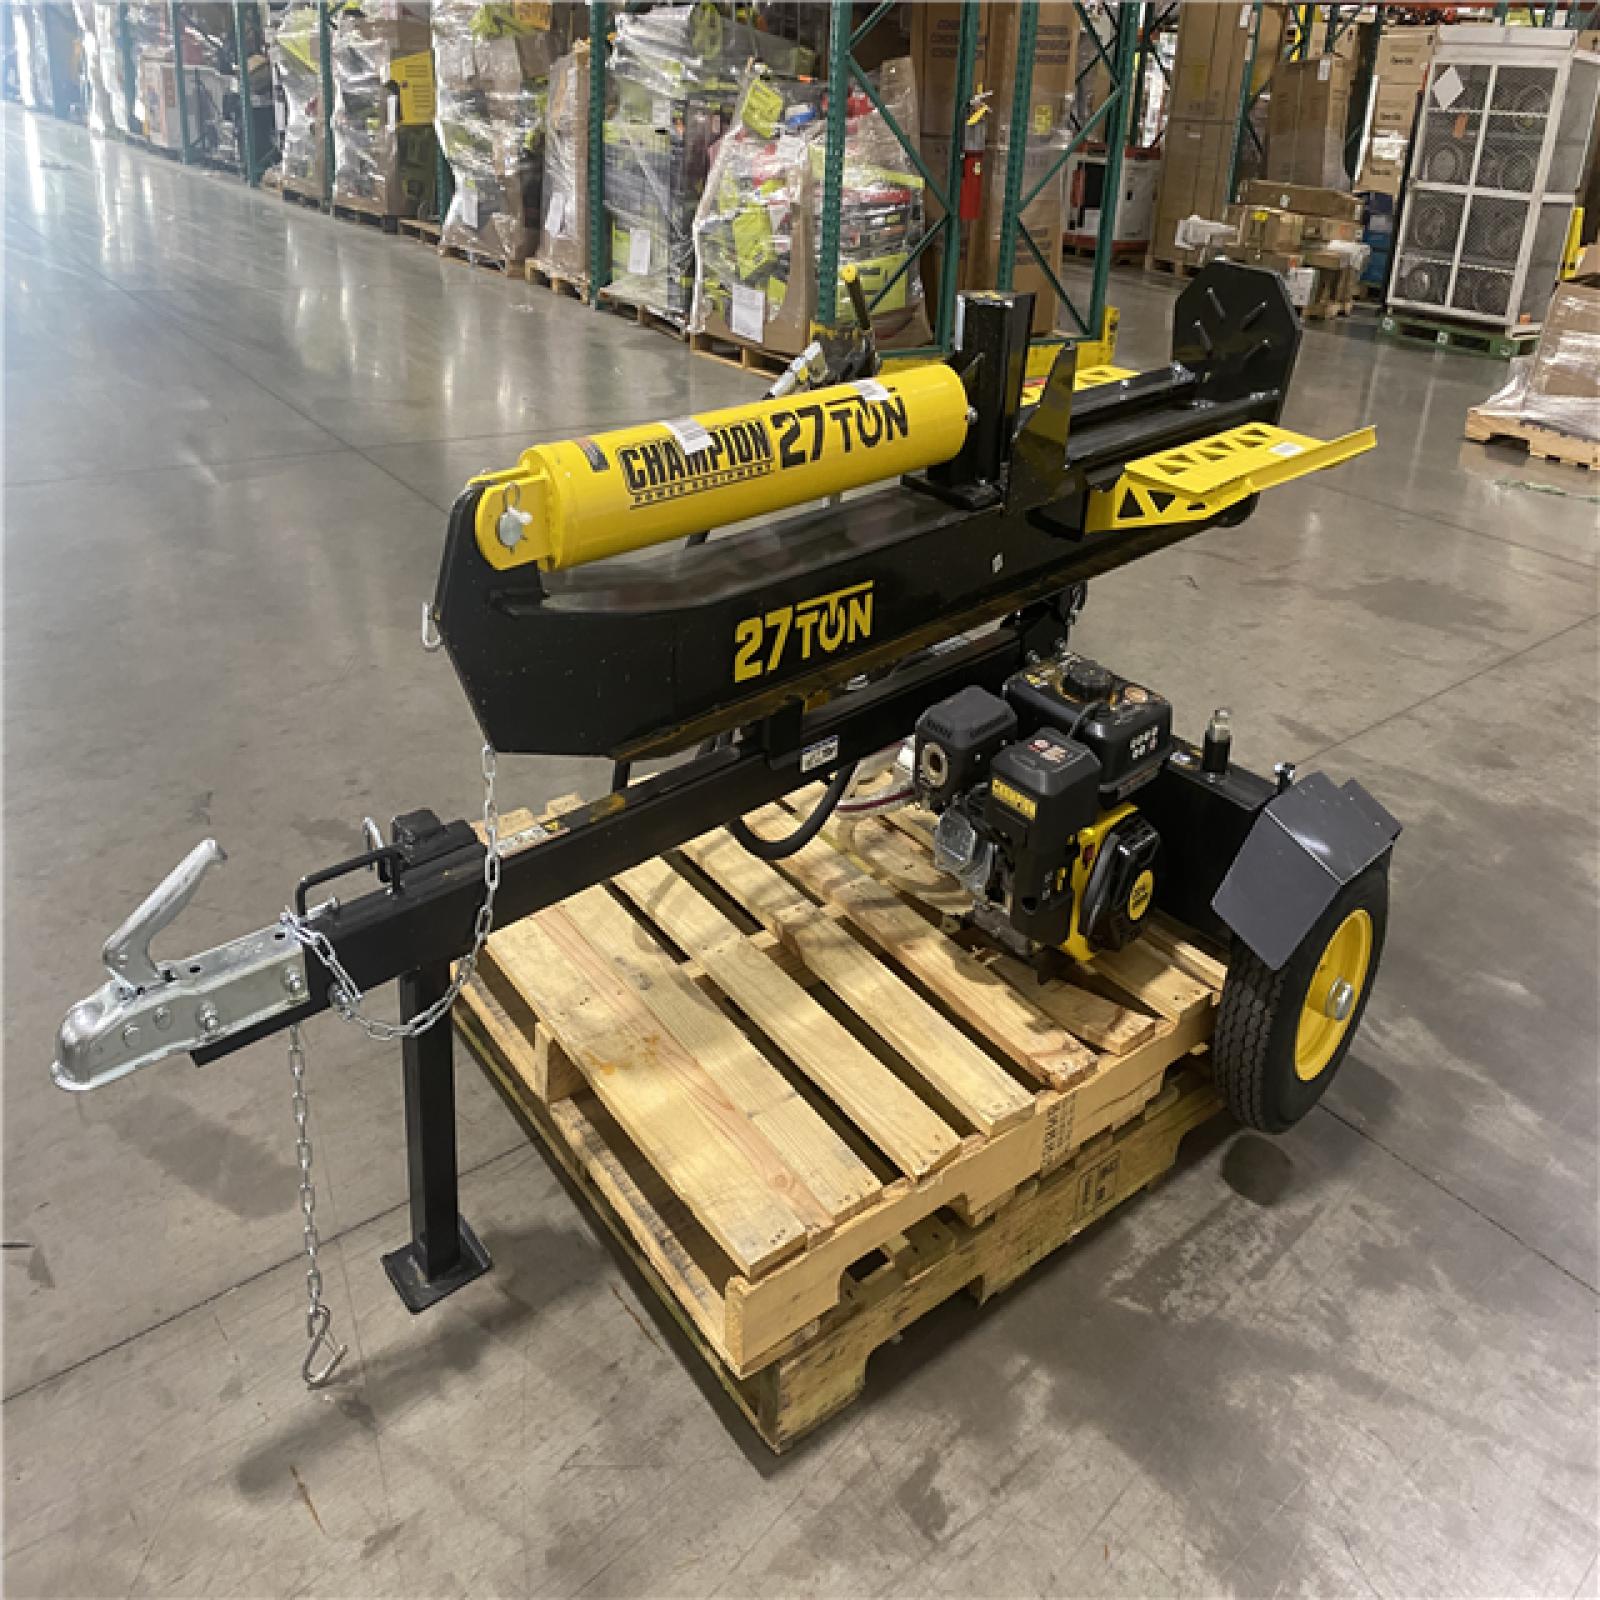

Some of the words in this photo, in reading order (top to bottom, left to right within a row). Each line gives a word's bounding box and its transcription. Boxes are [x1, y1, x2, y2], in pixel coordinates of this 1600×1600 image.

[770, 404, 823, 469] 27
[825, 392, 908, 453] TON
[735, 606, 793, 682] 27
[796, 583, 873, 660] TON
